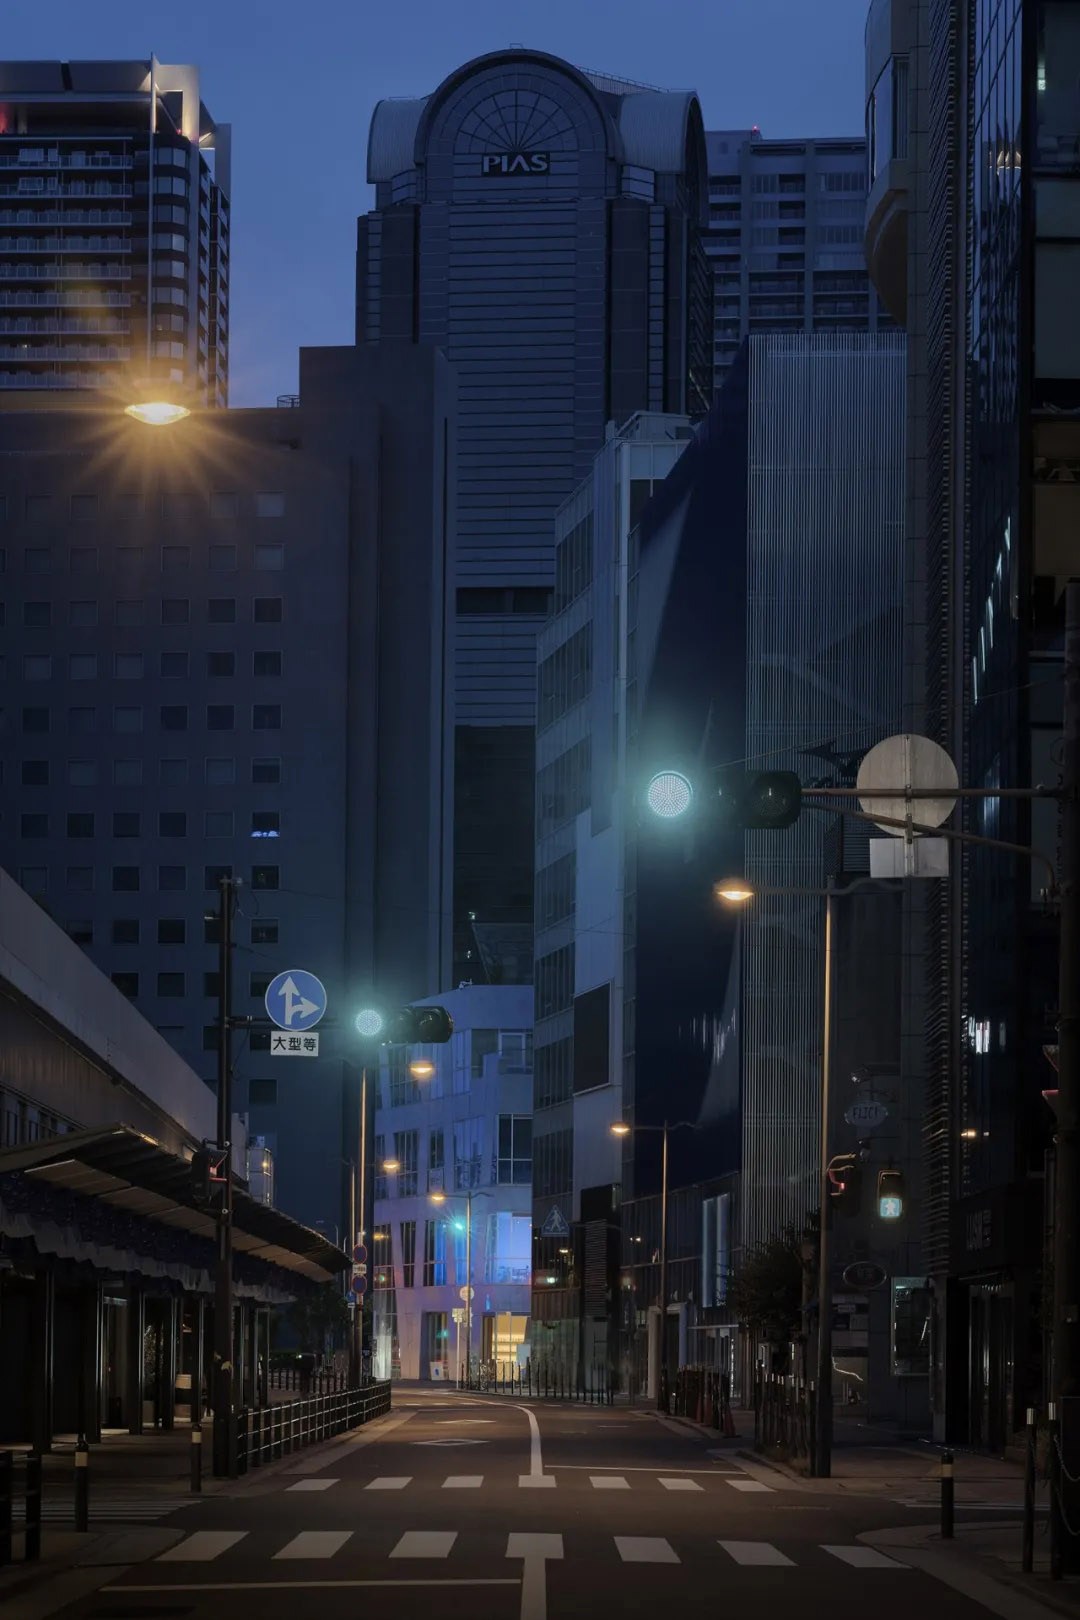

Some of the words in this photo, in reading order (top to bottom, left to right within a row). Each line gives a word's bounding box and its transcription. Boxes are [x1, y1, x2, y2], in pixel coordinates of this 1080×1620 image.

[483, 154, 548, 173] PIAS
[273, 1036, 317, 1052] 大型等
